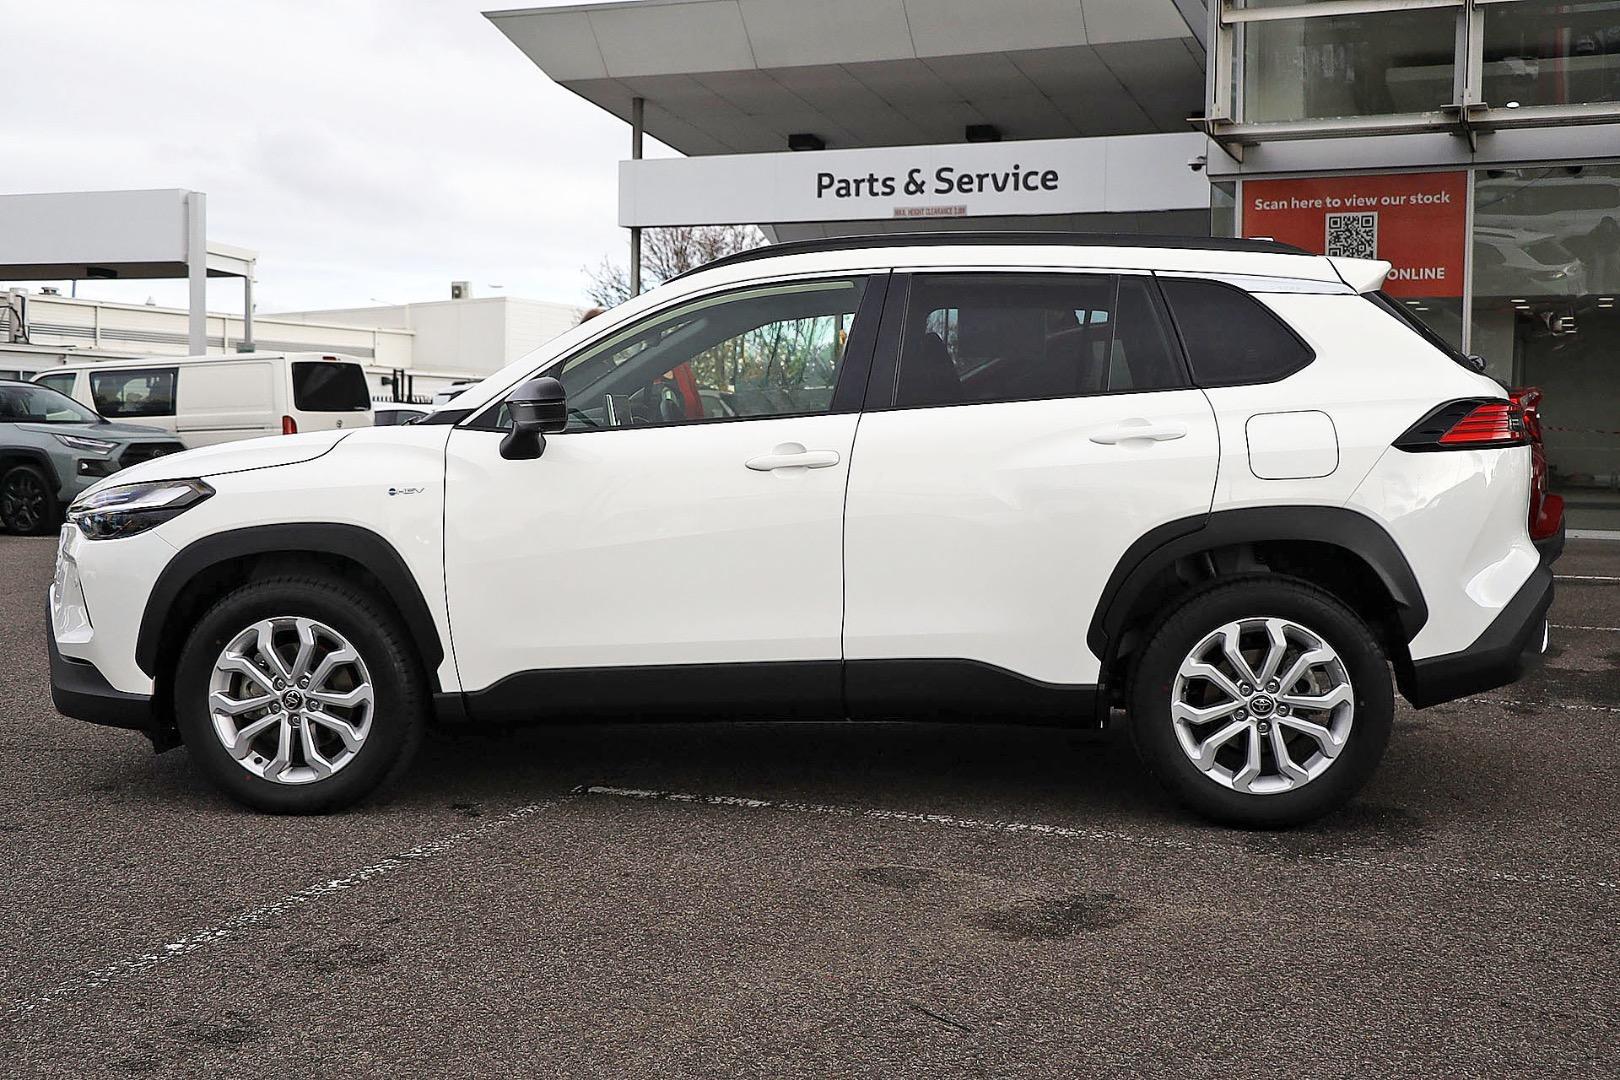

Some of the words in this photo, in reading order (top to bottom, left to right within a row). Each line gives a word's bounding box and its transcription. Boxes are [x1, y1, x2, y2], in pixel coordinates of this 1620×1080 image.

[817, 172, 896, 199] Parts
[903, 168, 926, 196] &
[934, 164, 1059, 195] Service
[1254, 198, 1287, 210] Scan
[1291, 197, 1322, 209] here
[1325, 196, 1341, 208] to
[1344, 194, 1377, 207] view
[1381, 195, 1407, 205] our
[1409, 191, 1451, 204] stock
[1386, 267, 1445, 281] ONLINE
